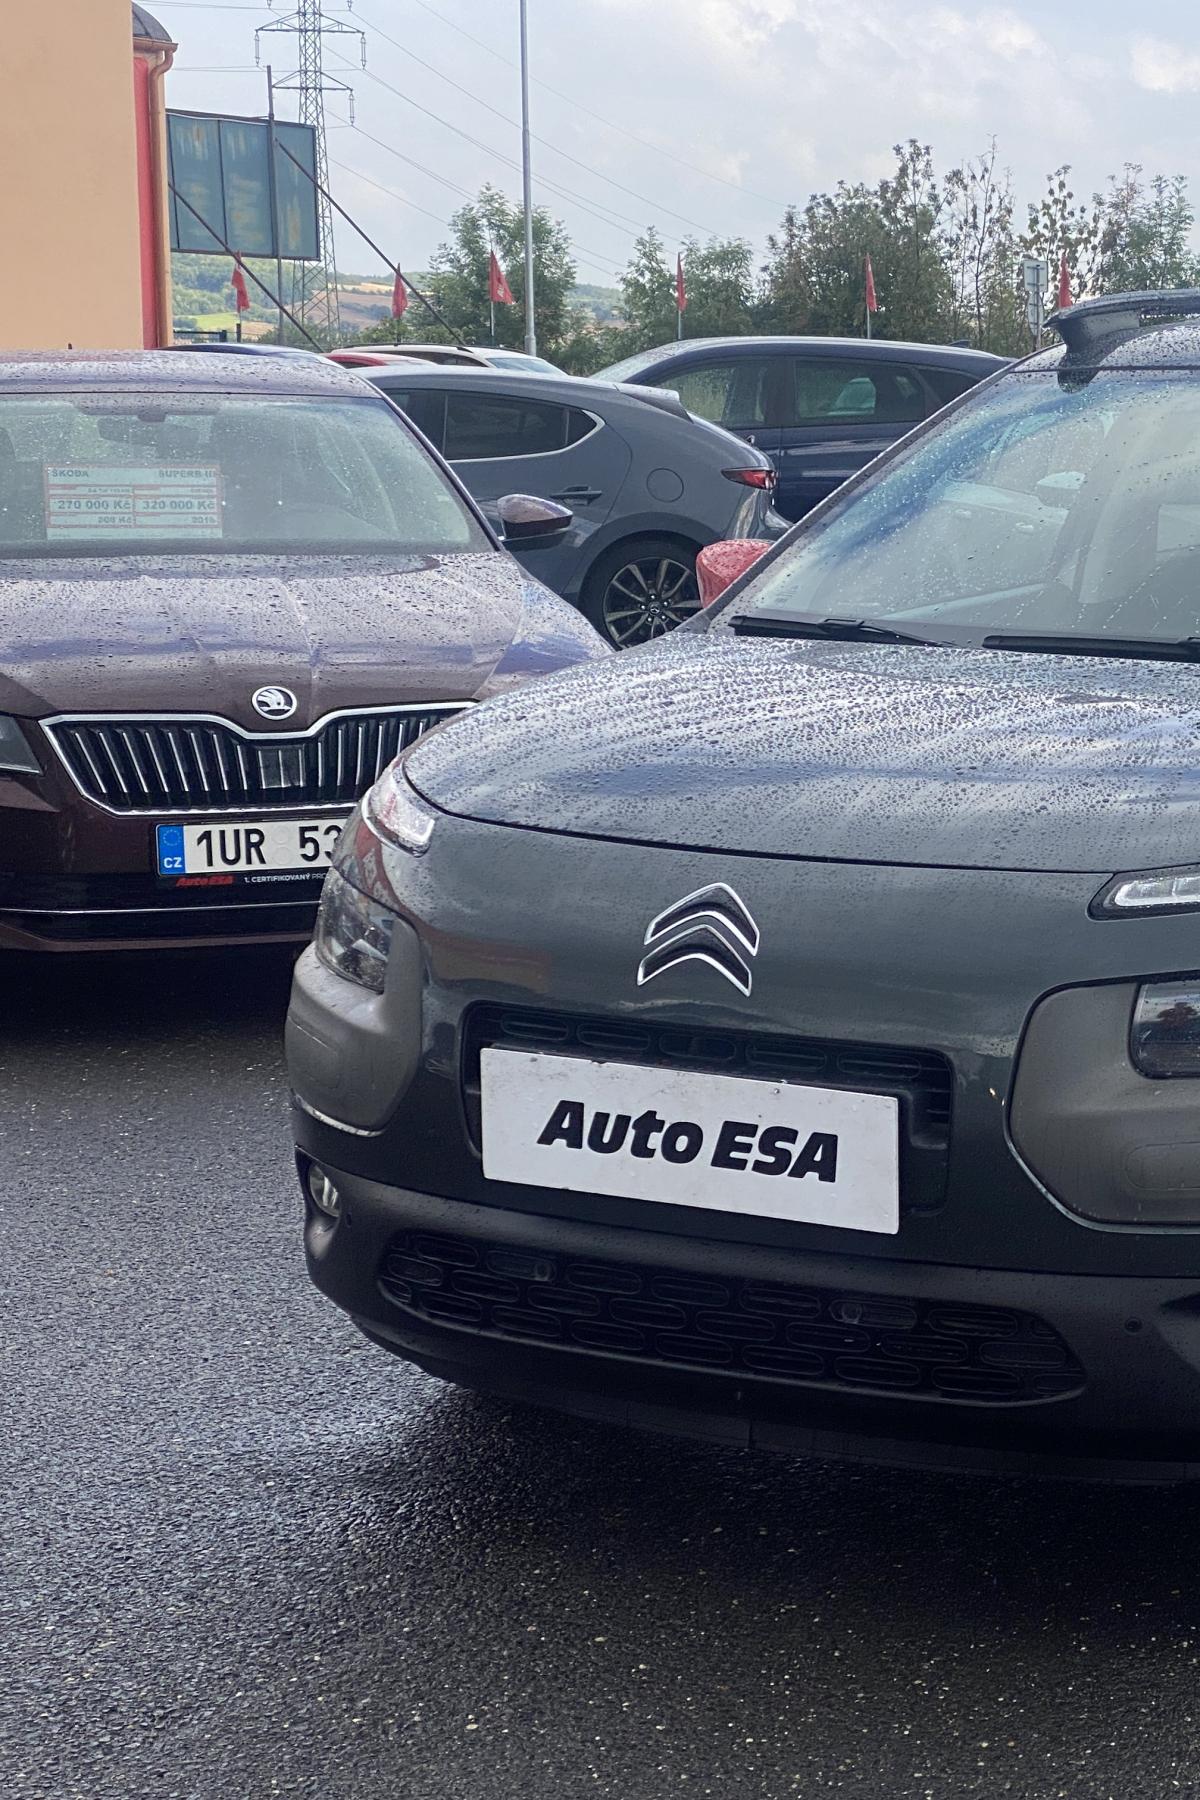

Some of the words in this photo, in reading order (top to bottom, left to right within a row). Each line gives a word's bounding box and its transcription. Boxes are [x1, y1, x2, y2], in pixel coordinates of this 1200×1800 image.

[57, 500, 81, 510] 270
[86, 500, 109, 510] 000
[113, 500, 131, 510] Kč
[142, 500, 166, 510] 320
[169, 500, 193, 510] 000
[197, 500, 215, 510] Kč
[196, 828, 267, 867] 1UR
[163, 857, 182, 868] CZ
[251, 873, 310, 883] CERTIFIKOVANÝ
